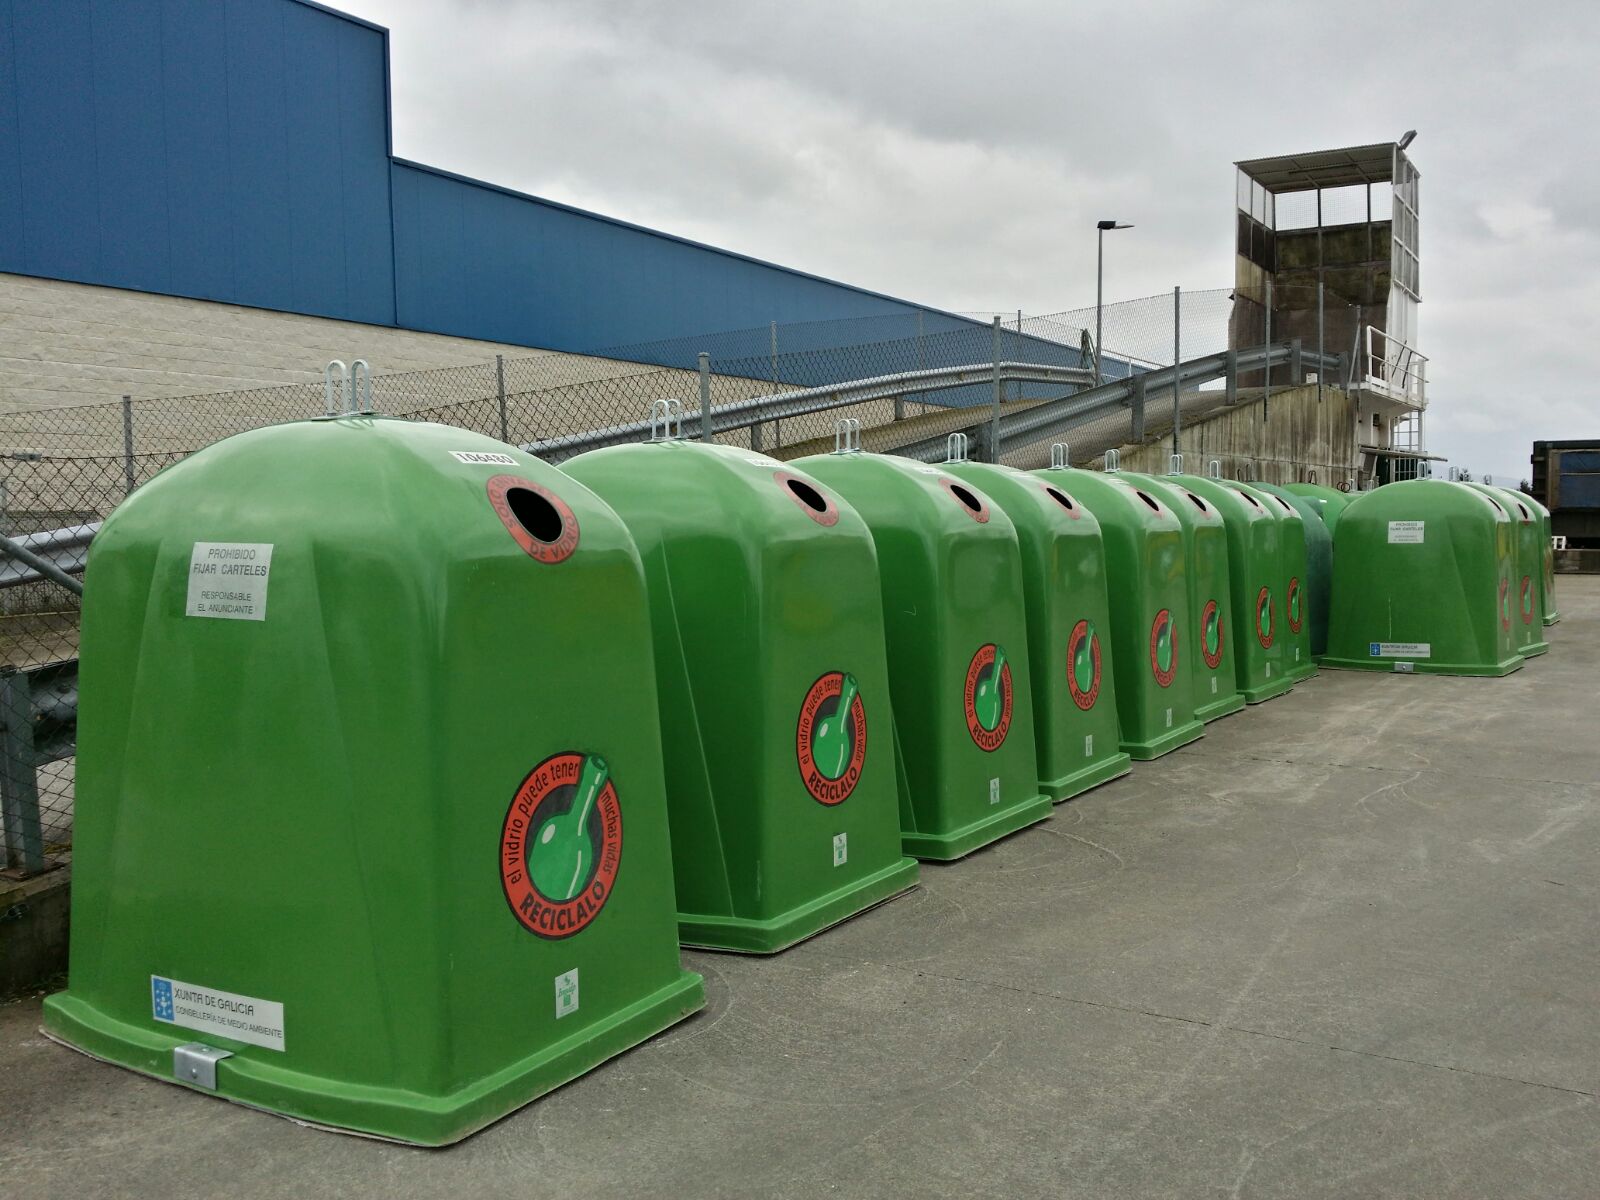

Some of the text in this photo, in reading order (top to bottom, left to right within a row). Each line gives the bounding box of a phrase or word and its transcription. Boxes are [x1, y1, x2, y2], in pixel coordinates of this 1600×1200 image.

[529, 515, 577, 560] DE VIDRIO
[207, 548, 256, 560] PROHIBIDO
[193, 563, 267, 577] FIJAR CARTELES
[197, 603, 254, 615] EL ANUNCIANTE
[201, 590, 252, 602] RESPONSABLE
[806, 686, 824, 718] puede
[800, 718, 810, 751] vidrio
[973, 721, 1007, 748] RECICLALO
[800, 754, 810, 765] el
[808, 767, 857, 800] RECICLALO
[505, 761, 579, 885] el vidrio puede tener
[600, 790, 617, 876] muchas vidas
[519, 880, 605, 931] RECICLALO
[174, 987, 254, 1016] XUNTA DE GALICIA
[217, 1016, 227, 1025] DE
[227, 1017, 248, 1031] MEDIO
[249, 1023, 283, 1039] AMBIENTE
